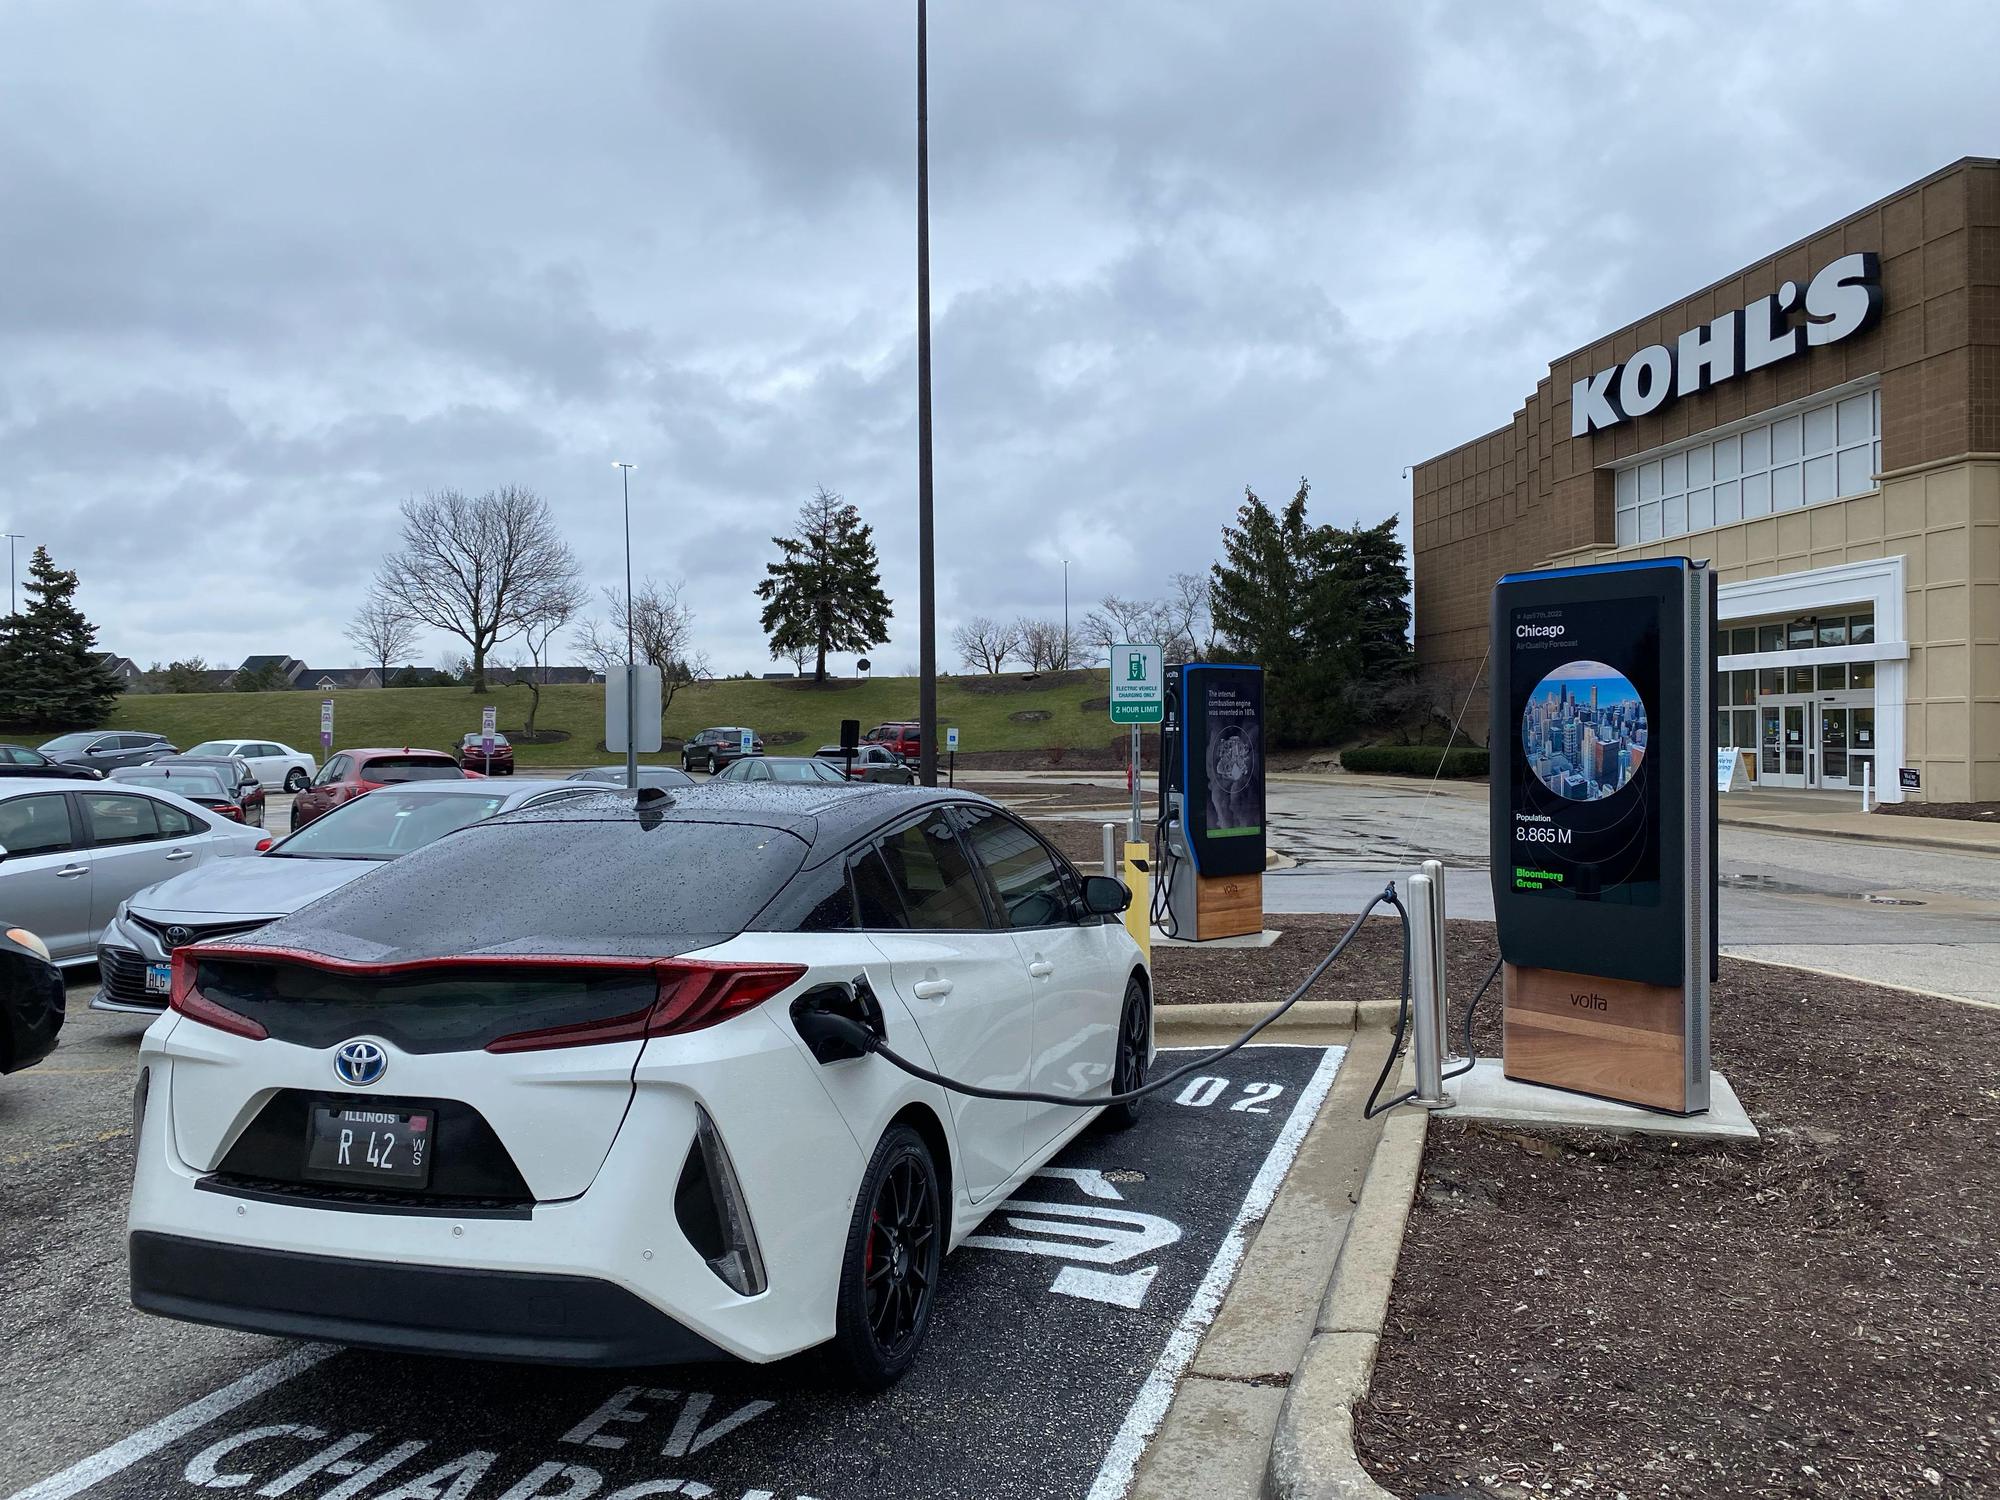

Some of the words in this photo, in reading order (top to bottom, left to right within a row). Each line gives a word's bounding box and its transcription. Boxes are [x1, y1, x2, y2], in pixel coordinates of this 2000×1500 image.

[1572, 252, 1876, 438] KOHL'S
[1516, 624, 1565, 638] Chicago
[1132, 663, 1138, 678] EV
[1115, 706, 1120, 714] 2
[1121, 706, 1140, 714] HOUR
[1140, 705, 1158, 713] LIMIT
[1516, 813, 1551, 822] Population
[1516, 826, 1556, 843] 8.865
[1558, 828, 1572, 844] M
[1516, 868, 1564, 882] Bloomberg
[1516, 878, 1543, 890] Green
[1570, 992, 1608, 1012] volta
[344, 1110, 396, 1124] ILLINOIS
[337, 1128, 353, 1166] R
[366, 1131, 396, 1169] 42
[558, 1384, 777, 1458] EV
